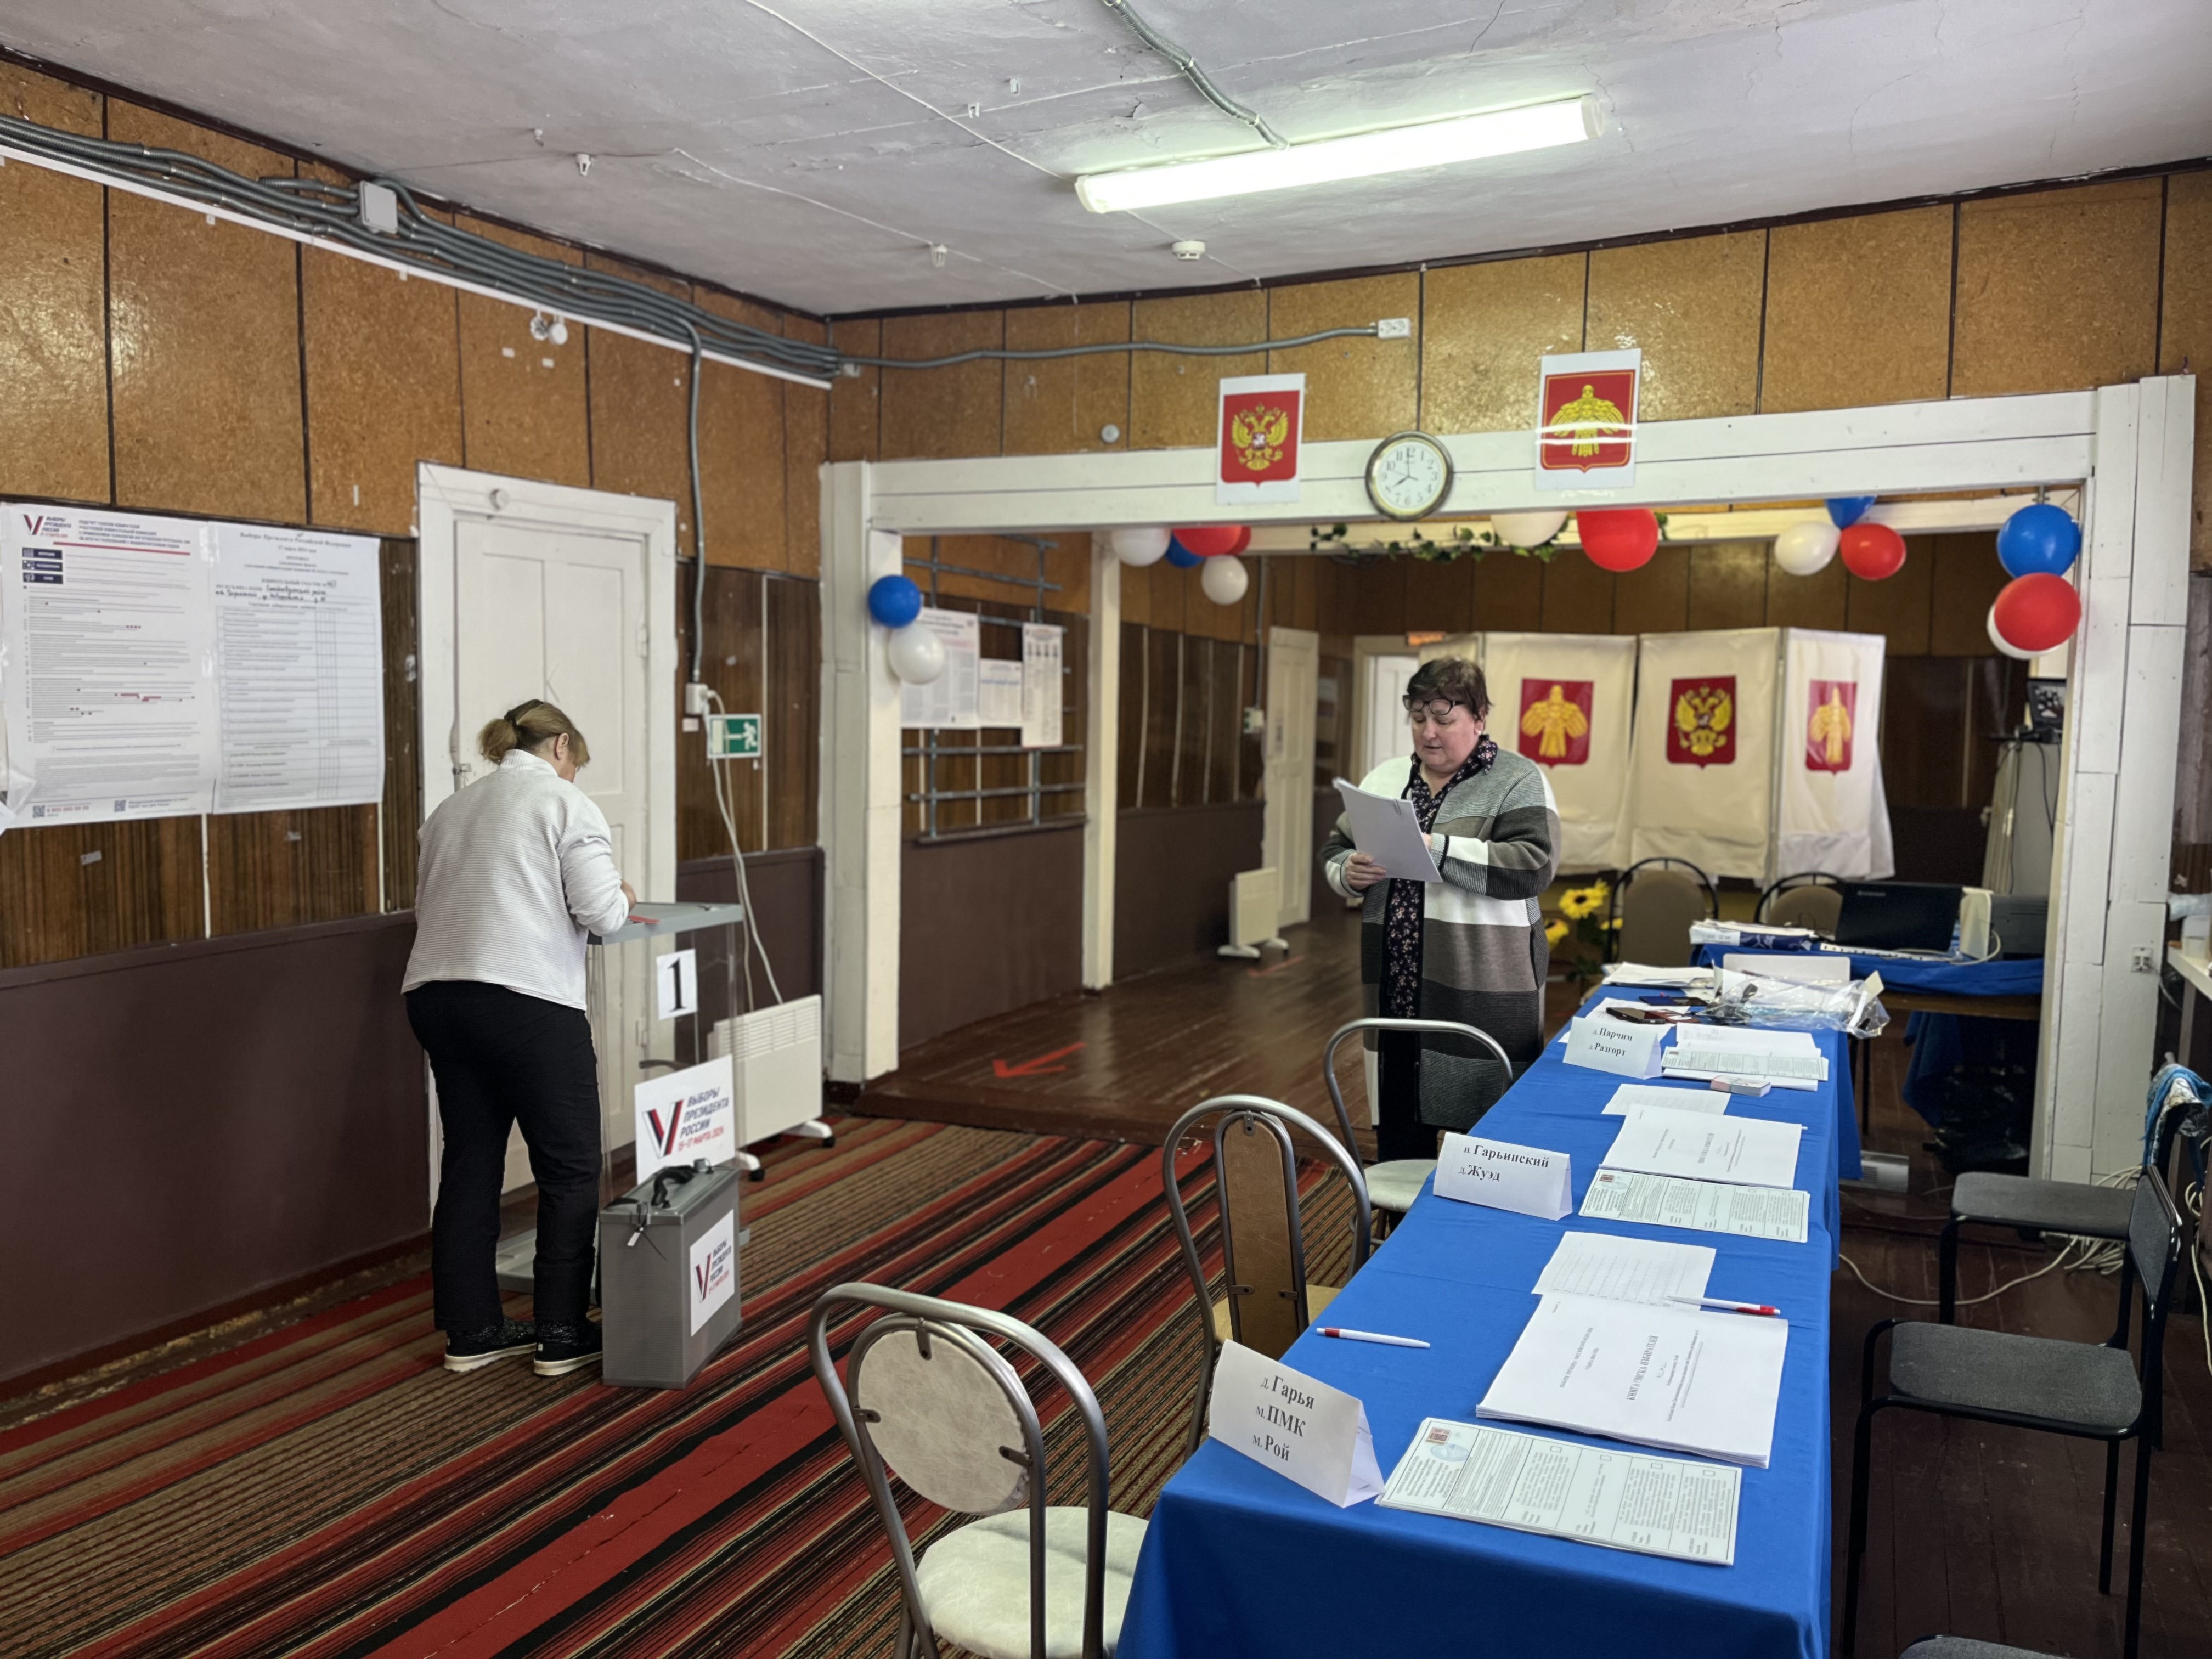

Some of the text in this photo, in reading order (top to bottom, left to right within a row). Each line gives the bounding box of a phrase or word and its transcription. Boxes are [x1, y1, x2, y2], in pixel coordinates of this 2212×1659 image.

[1396, 450, 1402, 461] 11
[1427, 459, 1434, 469] 2
[1431, 471, 1437, 481] 3
[1404, 496, 1410, 505] 6
[667, 956, 687, 1013] 1
[1599, 1028, 1633, 1041] Парчим
[1594, 1042, 1627, 1057] Разгорт
[687, 1086, 720, 1108] ВЫБОРЫ
[684, 1097, 729, 1122] ПРЕЗИДЕНТА
[680, 1118, 710, 1138] РОССИИ
[1473, 1145, 1549, 1168] Гарьинский
[1468, 1164, 1500, 1182] Жуэд
[1627, 1335, 1659, 1400] КНИГА СПИСКА ИЗБИРАТЕЛЕЙ
[1261, 1375, 1315, 1409] д. Гарья
[1256, 1404, 1306, 1437] м. ПМК
[1252, 1434, 1289, 1462] м. Рой
